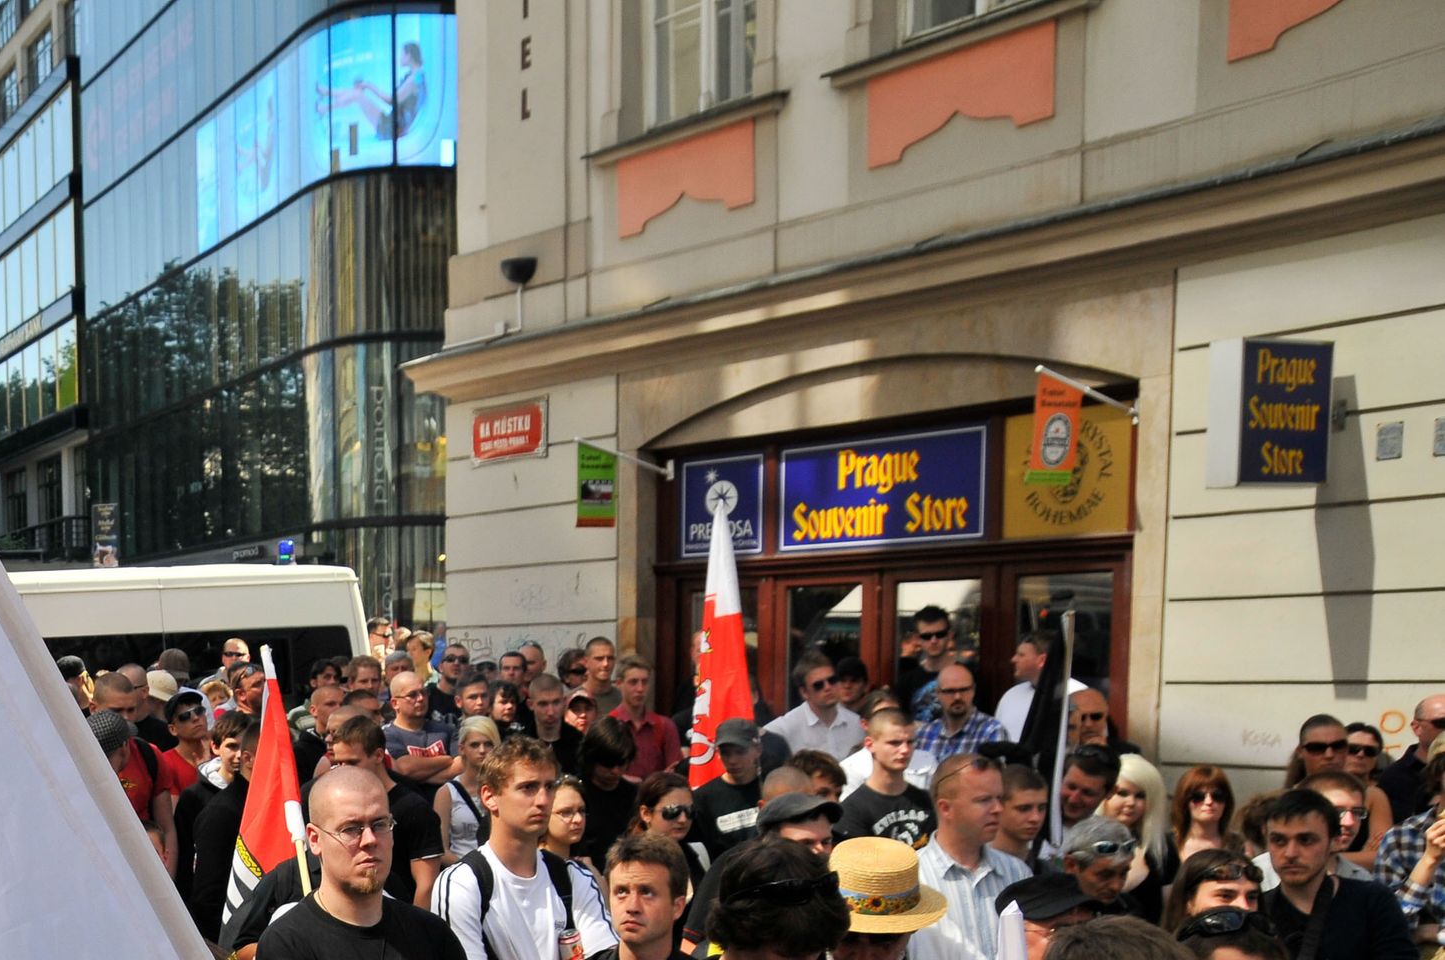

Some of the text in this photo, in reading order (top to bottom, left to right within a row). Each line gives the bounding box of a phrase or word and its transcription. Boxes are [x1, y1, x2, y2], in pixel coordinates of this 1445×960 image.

[1256, 347, 1317, 393] Prague
[1248, 394, 1320, 432] Souvenir
[370, 386, 388, 504] promod
[1260, 440, 1304, 476] Store
[836, 449, 920, 495] Prague
[689, 519, 754, 541] PREOSA
[792, 491, 969, 542] Souvenir Store
